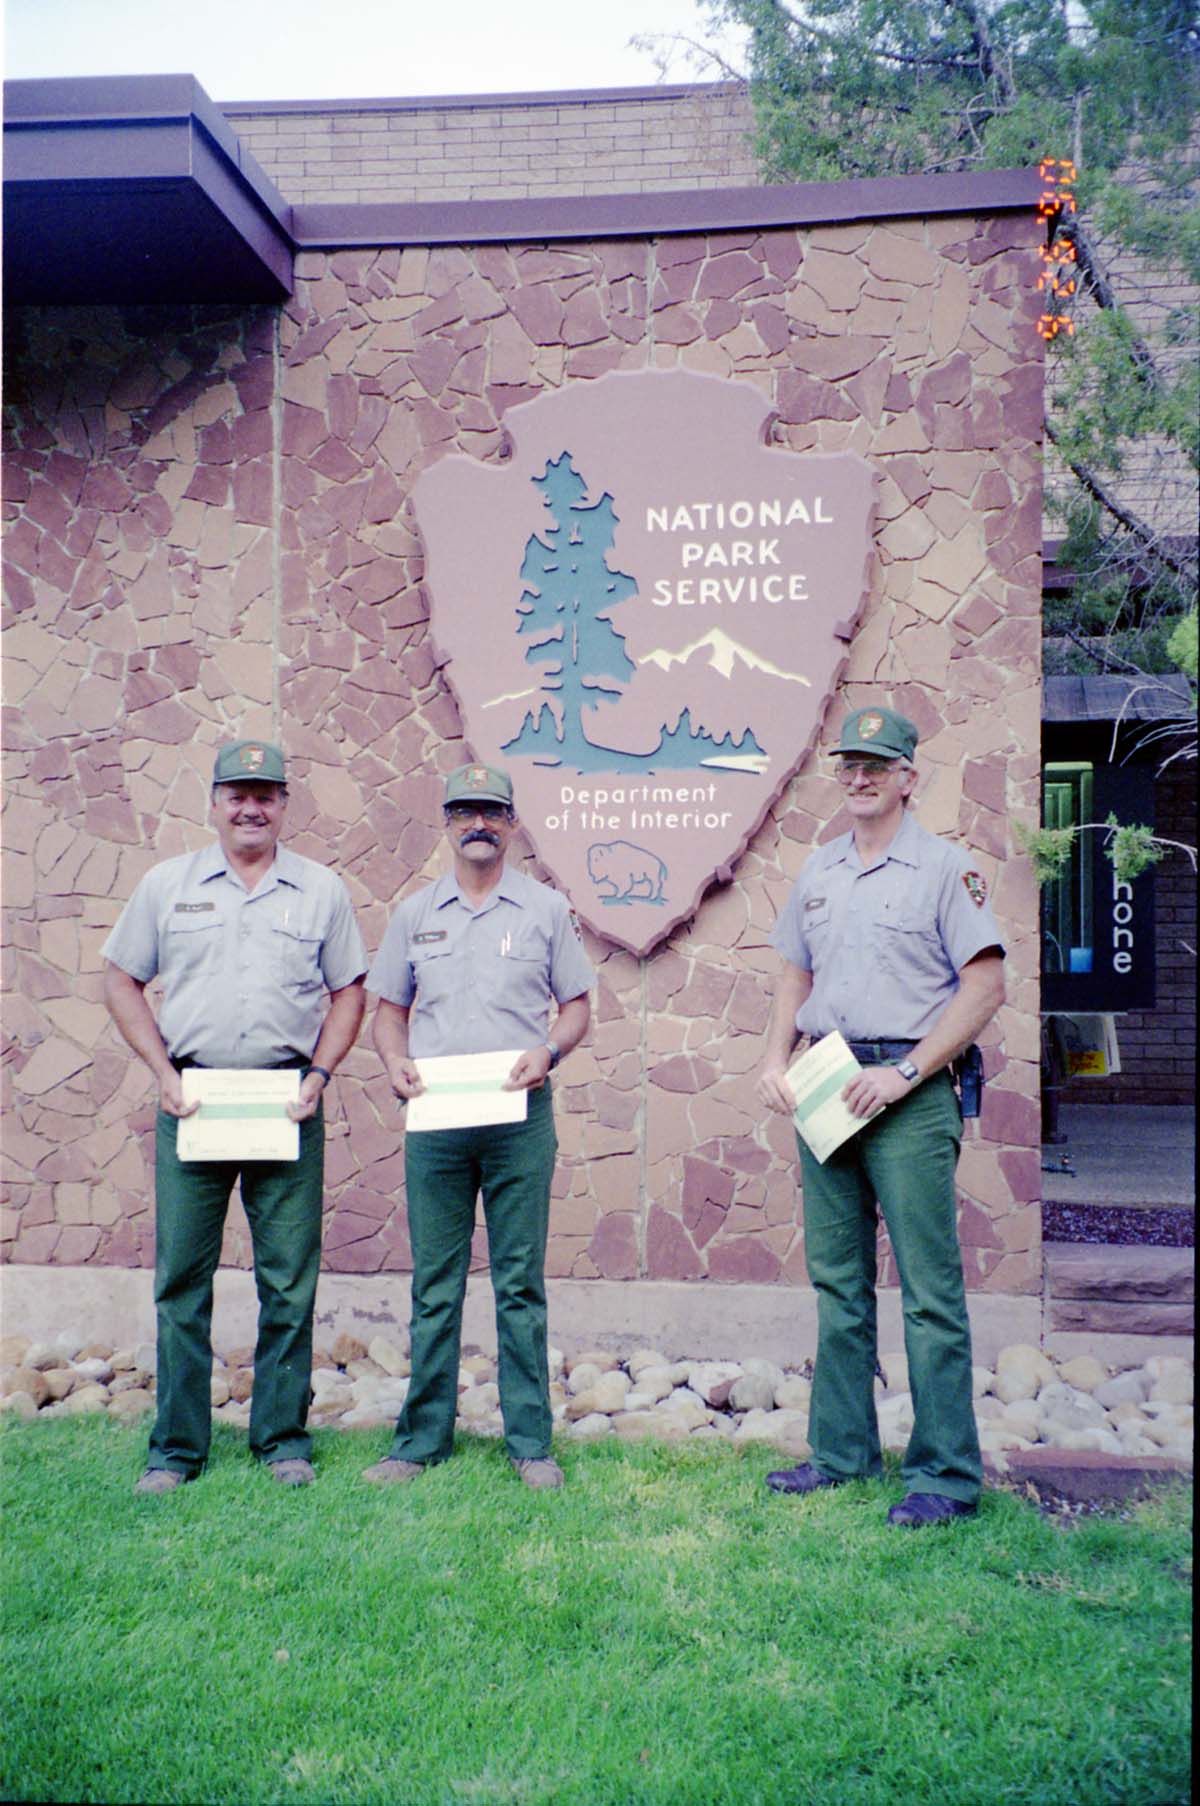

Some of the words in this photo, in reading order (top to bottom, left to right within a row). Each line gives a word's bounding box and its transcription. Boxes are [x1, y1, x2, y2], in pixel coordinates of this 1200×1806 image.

[646, 496, 834, 532] NATIONAL
[682, 538, 781, 568] PARK
[651, 574, 809, 606] SERVICE
[561, 783, 717, 809] Department
[545, 809, 571, 831] of
[580, 811, 621, 830] the
[631, 809, 732, 829] Interior
[1113, 842, 1133, 974] hone
